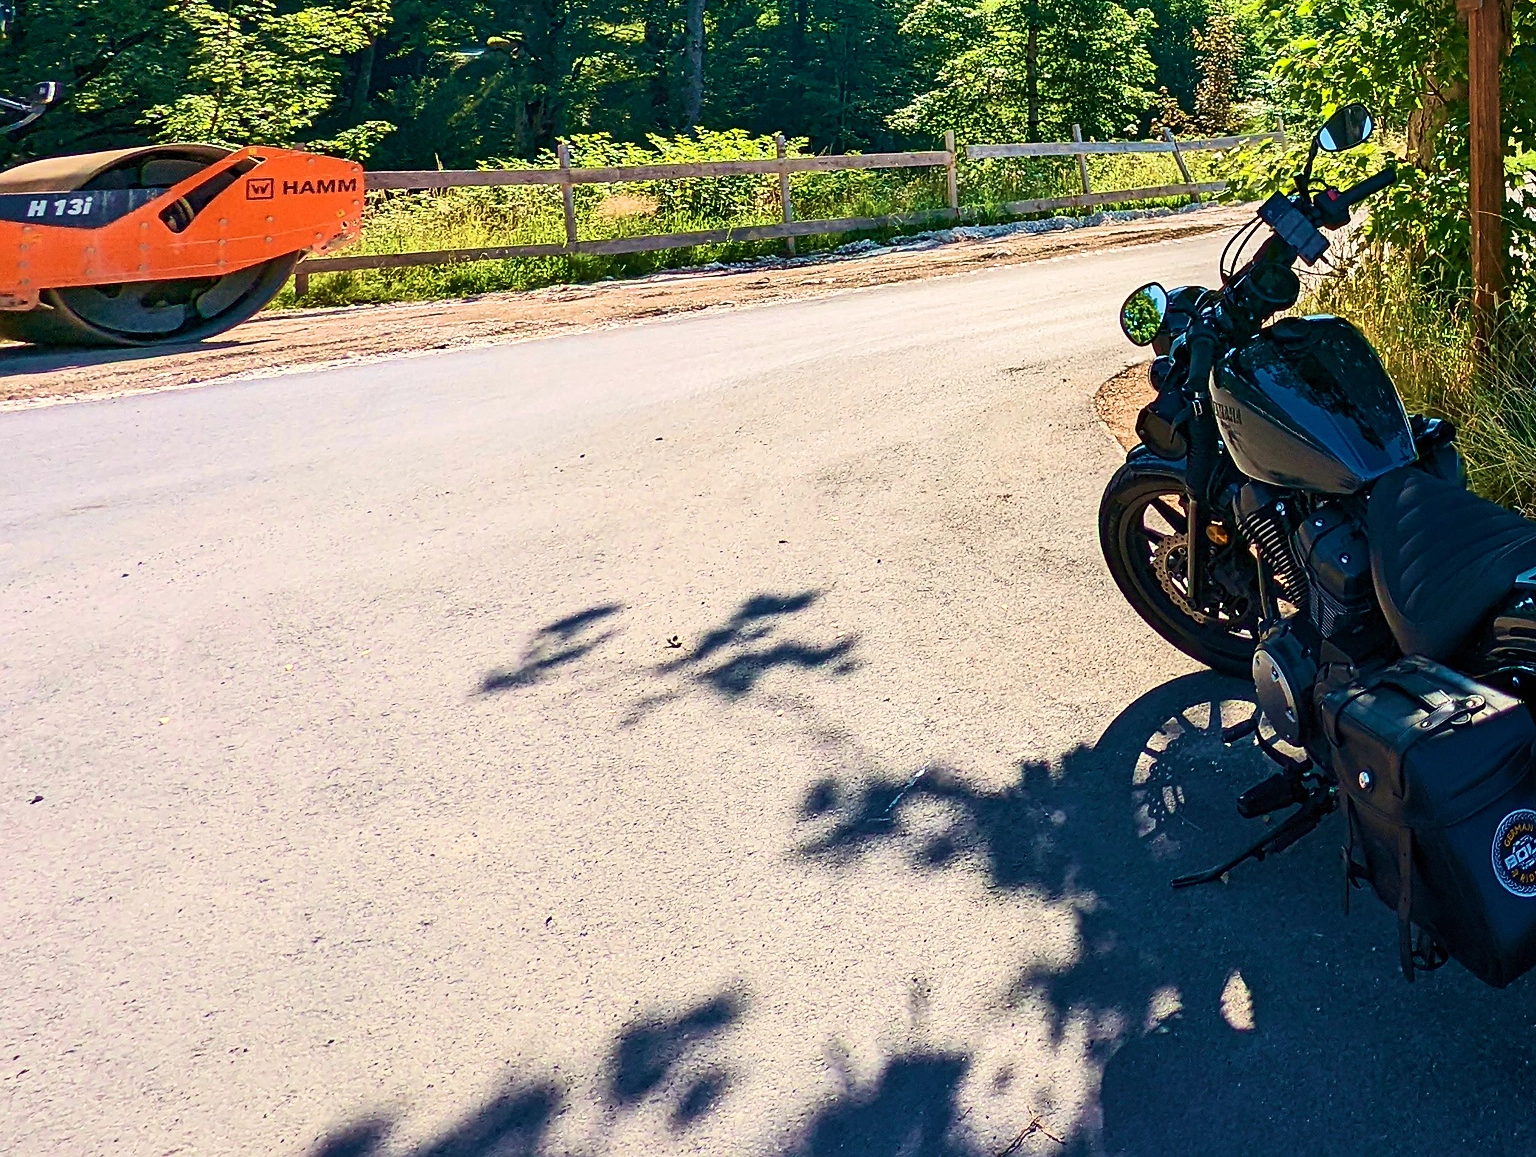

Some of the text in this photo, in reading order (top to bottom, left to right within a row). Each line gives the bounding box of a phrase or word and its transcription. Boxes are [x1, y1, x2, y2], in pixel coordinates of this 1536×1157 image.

[282, 178, 358, 196] HAMM
[27, 198, 92, 217] H 13i
[1503, 823, 1534, 848] GERMAN
